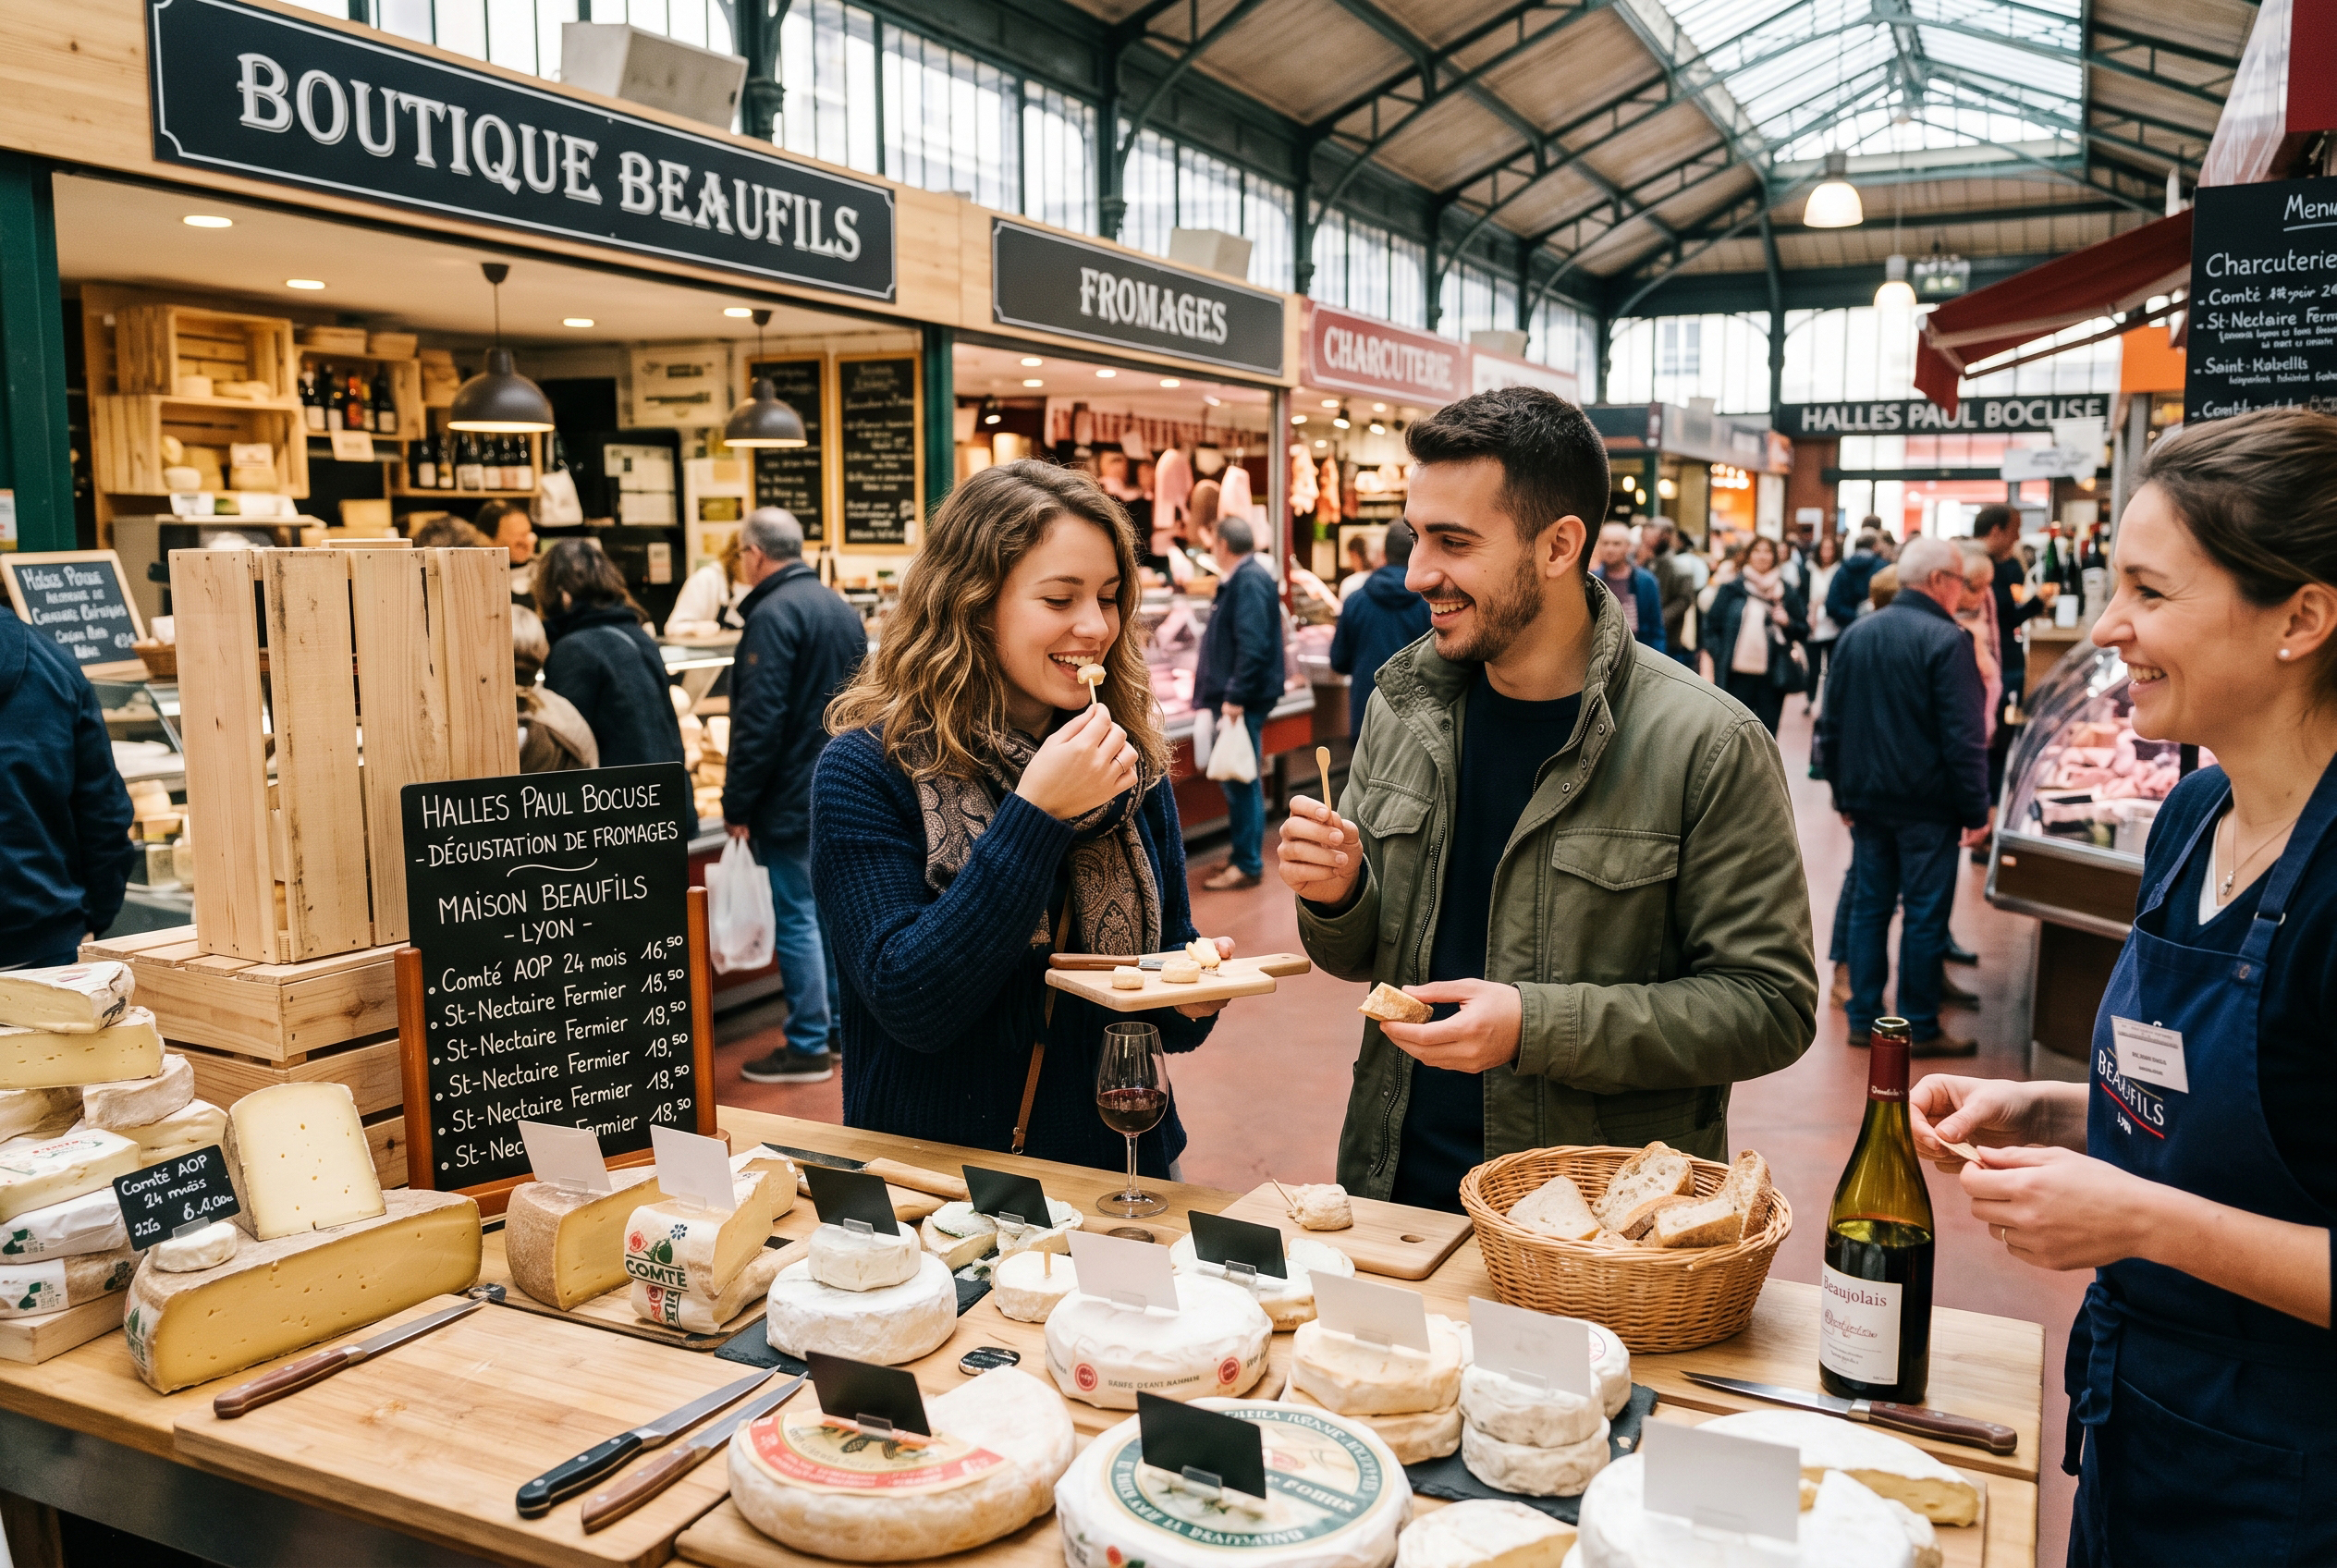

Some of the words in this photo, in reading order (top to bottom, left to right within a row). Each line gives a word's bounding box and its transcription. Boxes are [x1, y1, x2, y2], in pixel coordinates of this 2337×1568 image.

[236, 52, 603, 205] BOUTIQUE
[618, 151, 862, 263] BEAUFILS
[2206, 249, 2337, 277] Charcuterie
[1080, 266, 1228, 345] FROMAGES
[2209, 286, 2261, 306] Comté
[1323, 325, 1453, 390] CHARCUTERIE
[1802, 403, 1902, 432] HALLES
[1907, 402, 1978, 430] PAUL
[1984, 398, 2102, 428] BOCUSE
[422, 794, 509, 828] HALLES
[520, 786, 573, 818] PAUL
[581, 784, 661, 813] BOCUSE
[564, 831, 587, 851] DE
[593, 821, 678, 848] FROMAGES
[542, 874, 648, 912] BEAUFILS
[442, 961, 502, 993] Comté
[514, 955, 552, 982] AOP
[563, 953, 583, 974] 24
[591, 948, 627, 969] mois
[445, 992, 555, 1027] St-Nectaire
[564, 982, 626, 1007] Fermier
[447, 1028, 557, 1062] St-Nectaire
[565, 1016, 628, 1041] Fermier
[449, 1062, 558, 1097] St-Nectaire
[568, 1049, 630, 1074] Fermier
[2098, 1048, 2164, 1126] BEAUFILS
[452, 1096, 563, 1133] St-Nectaire
[570, 1082, 632, 1108] Fermier
[121, 1167, 171, 1195] Comté
[177, 1155, 207, 1177] AOP
[1824, 1275, 1887, 1307] Beaujolais
